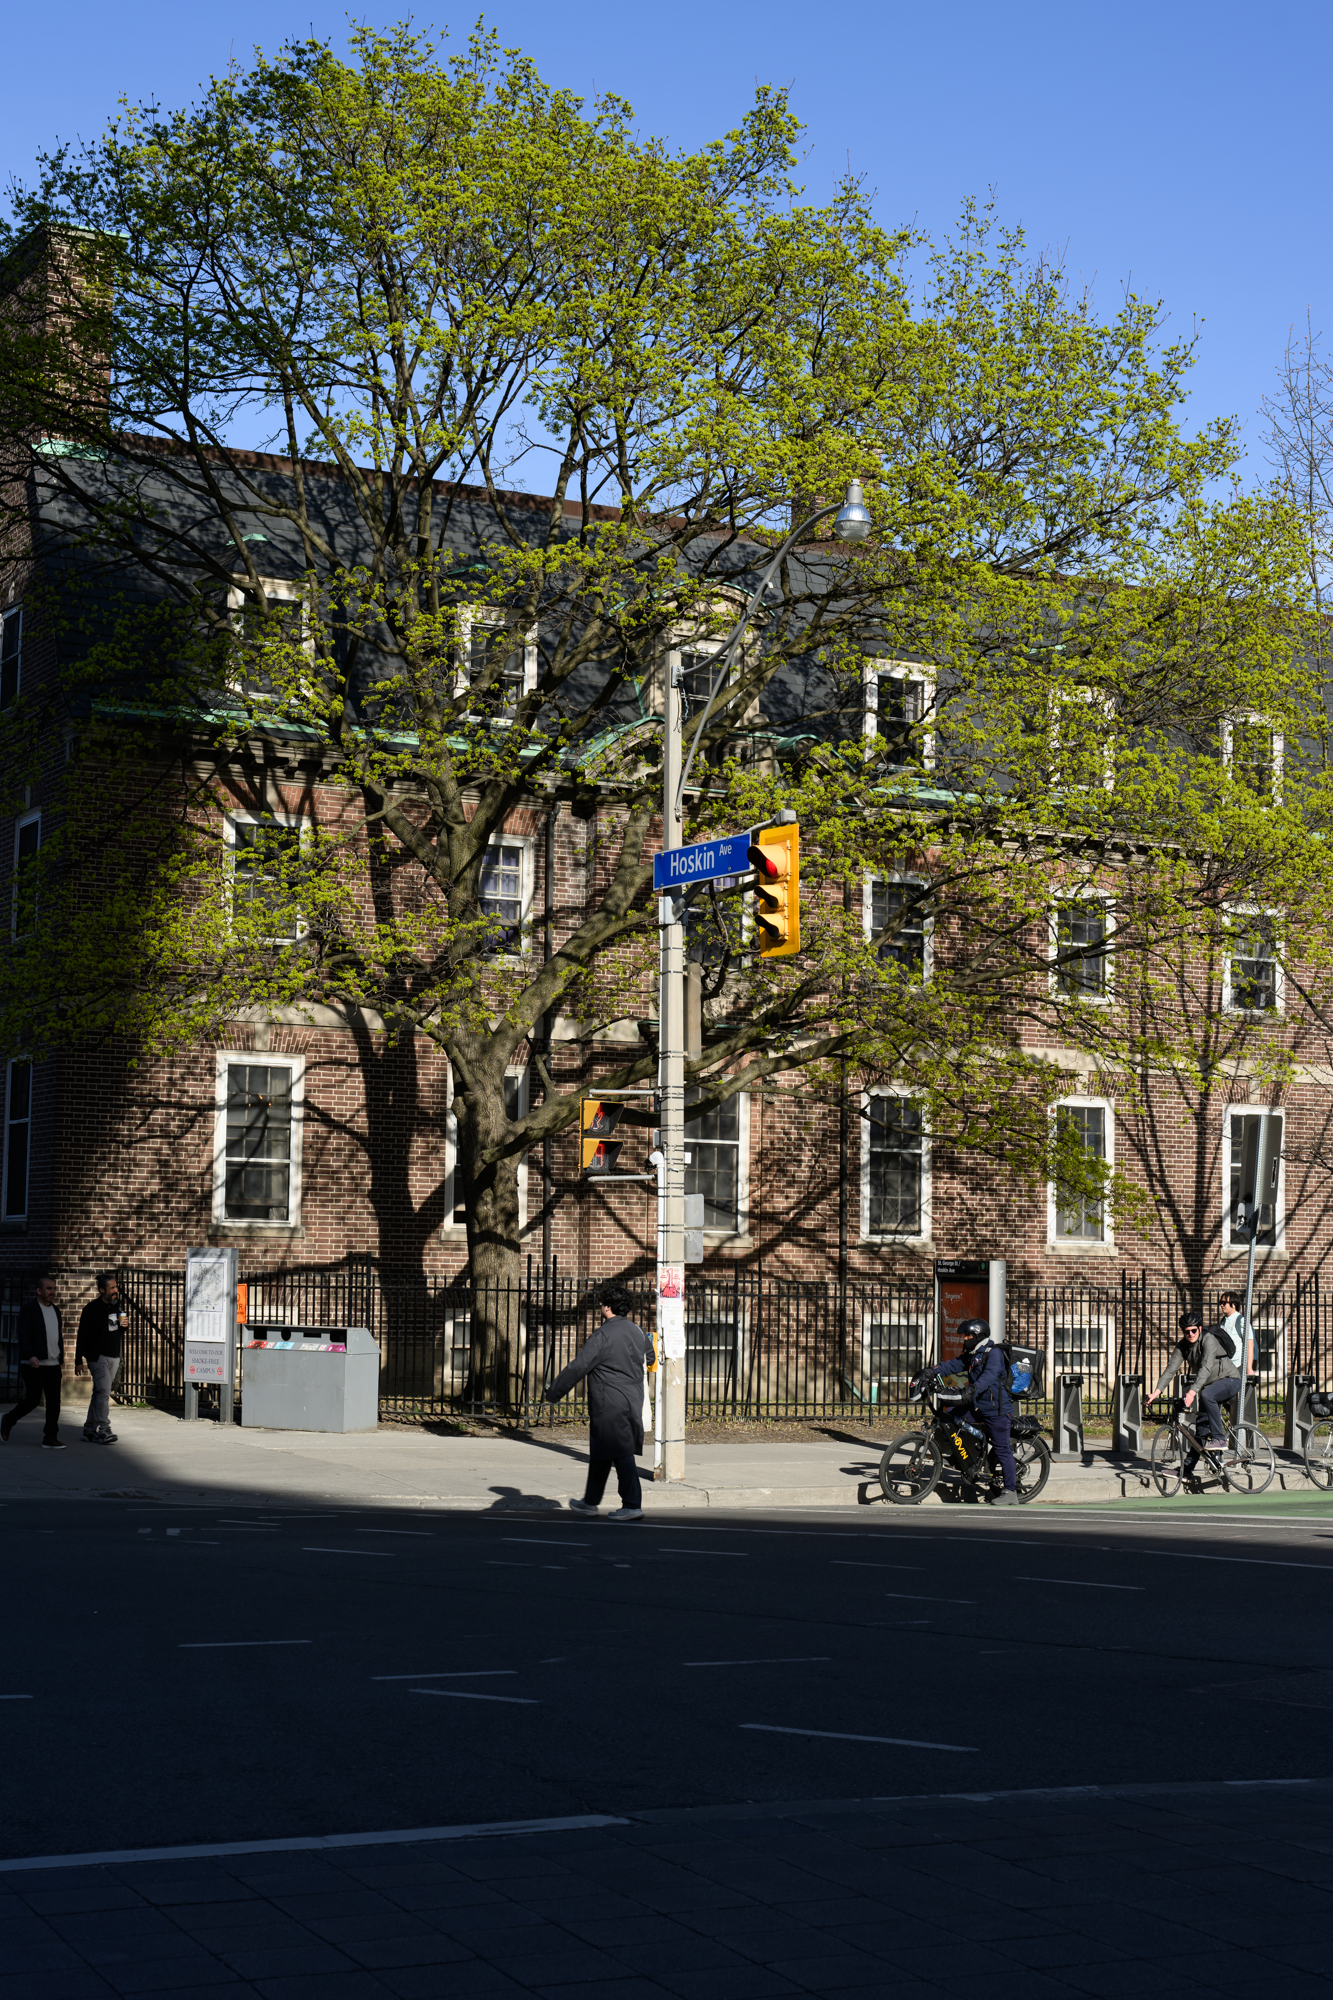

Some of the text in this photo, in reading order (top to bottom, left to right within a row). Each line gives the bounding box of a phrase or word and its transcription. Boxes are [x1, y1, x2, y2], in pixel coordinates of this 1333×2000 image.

[670, 843, 733, 877] Hoskin Ave
[945, 1292, 960, 1300] Tangerine
[945, 1316, 954, 1324] Your
[950, 1335, 960, 1344] stay
[191, 1357, 221, 1365] SMOKE-FREE
